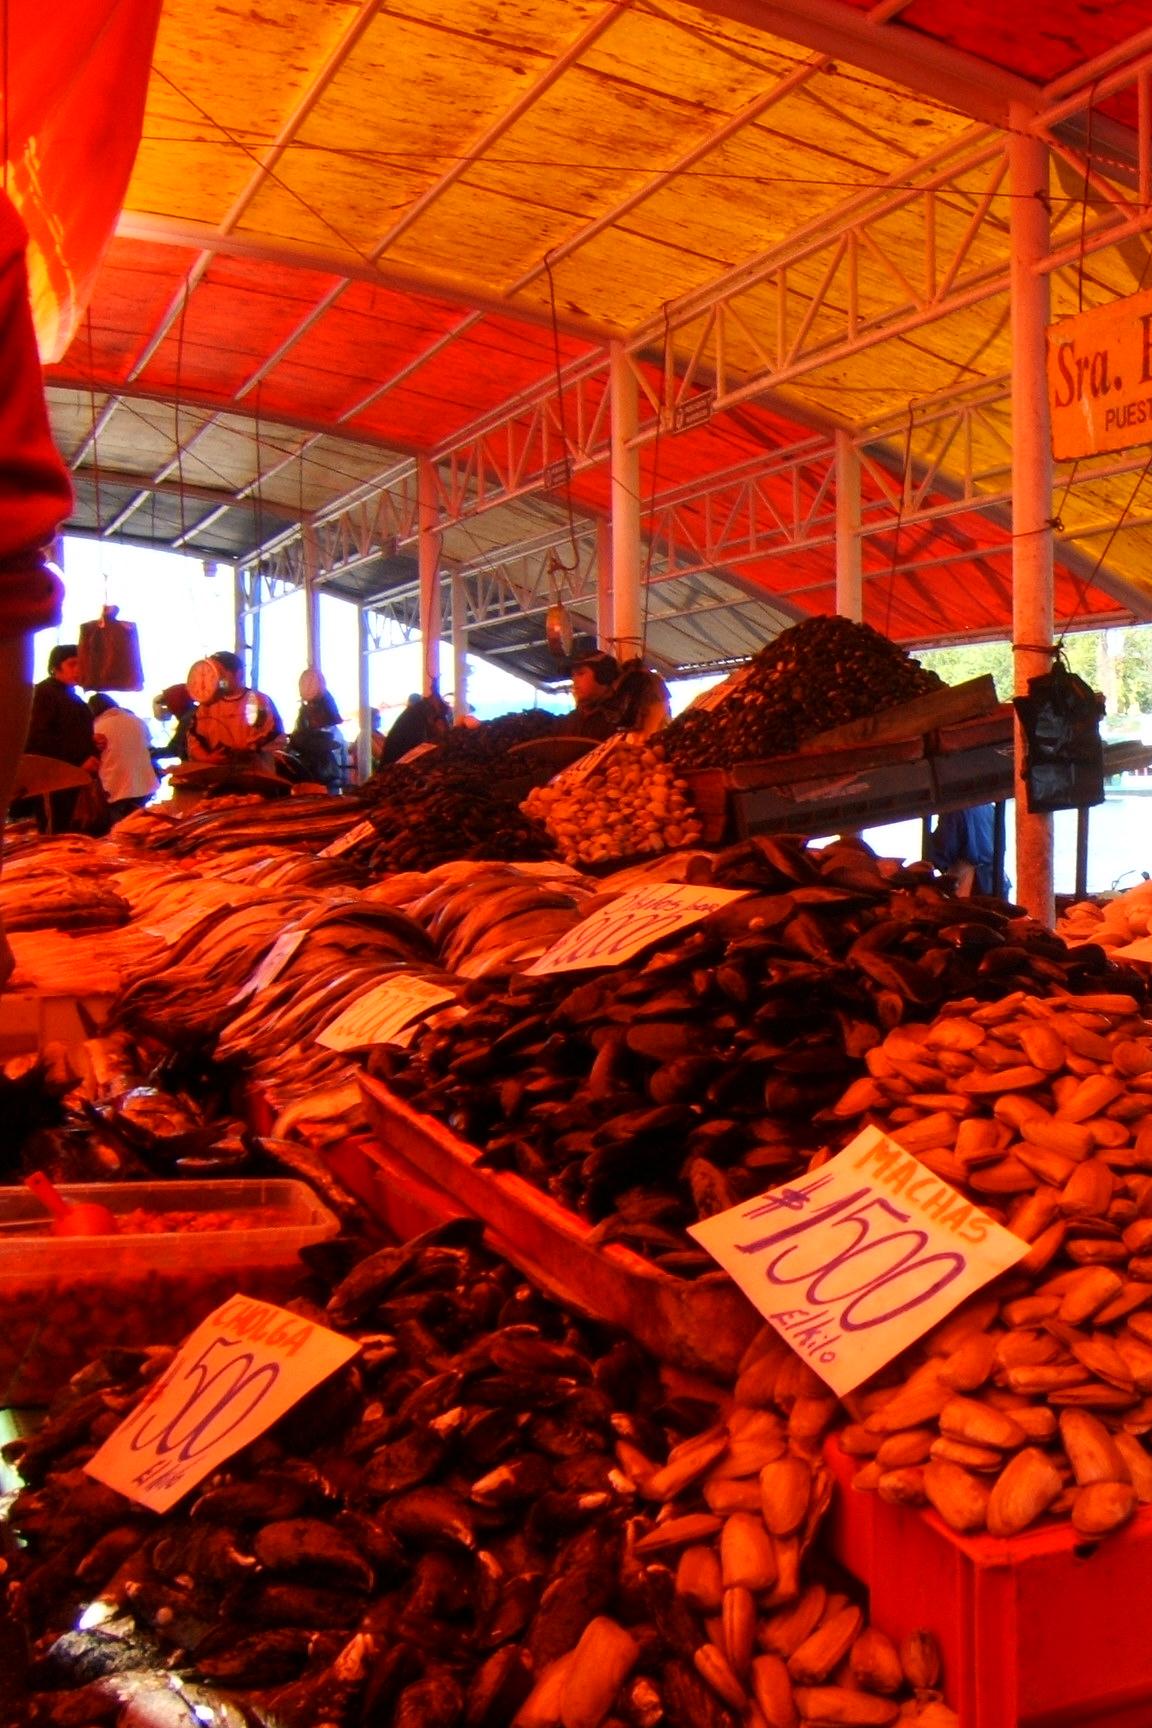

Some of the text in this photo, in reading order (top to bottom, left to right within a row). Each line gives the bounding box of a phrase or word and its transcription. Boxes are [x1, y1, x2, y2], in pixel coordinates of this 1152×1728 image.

[1055, 342, 1122, 408] Sra.
[854, 1138, 996, 1244] MACHAS
[212, 1301, 315, 1358] CHOLGA
